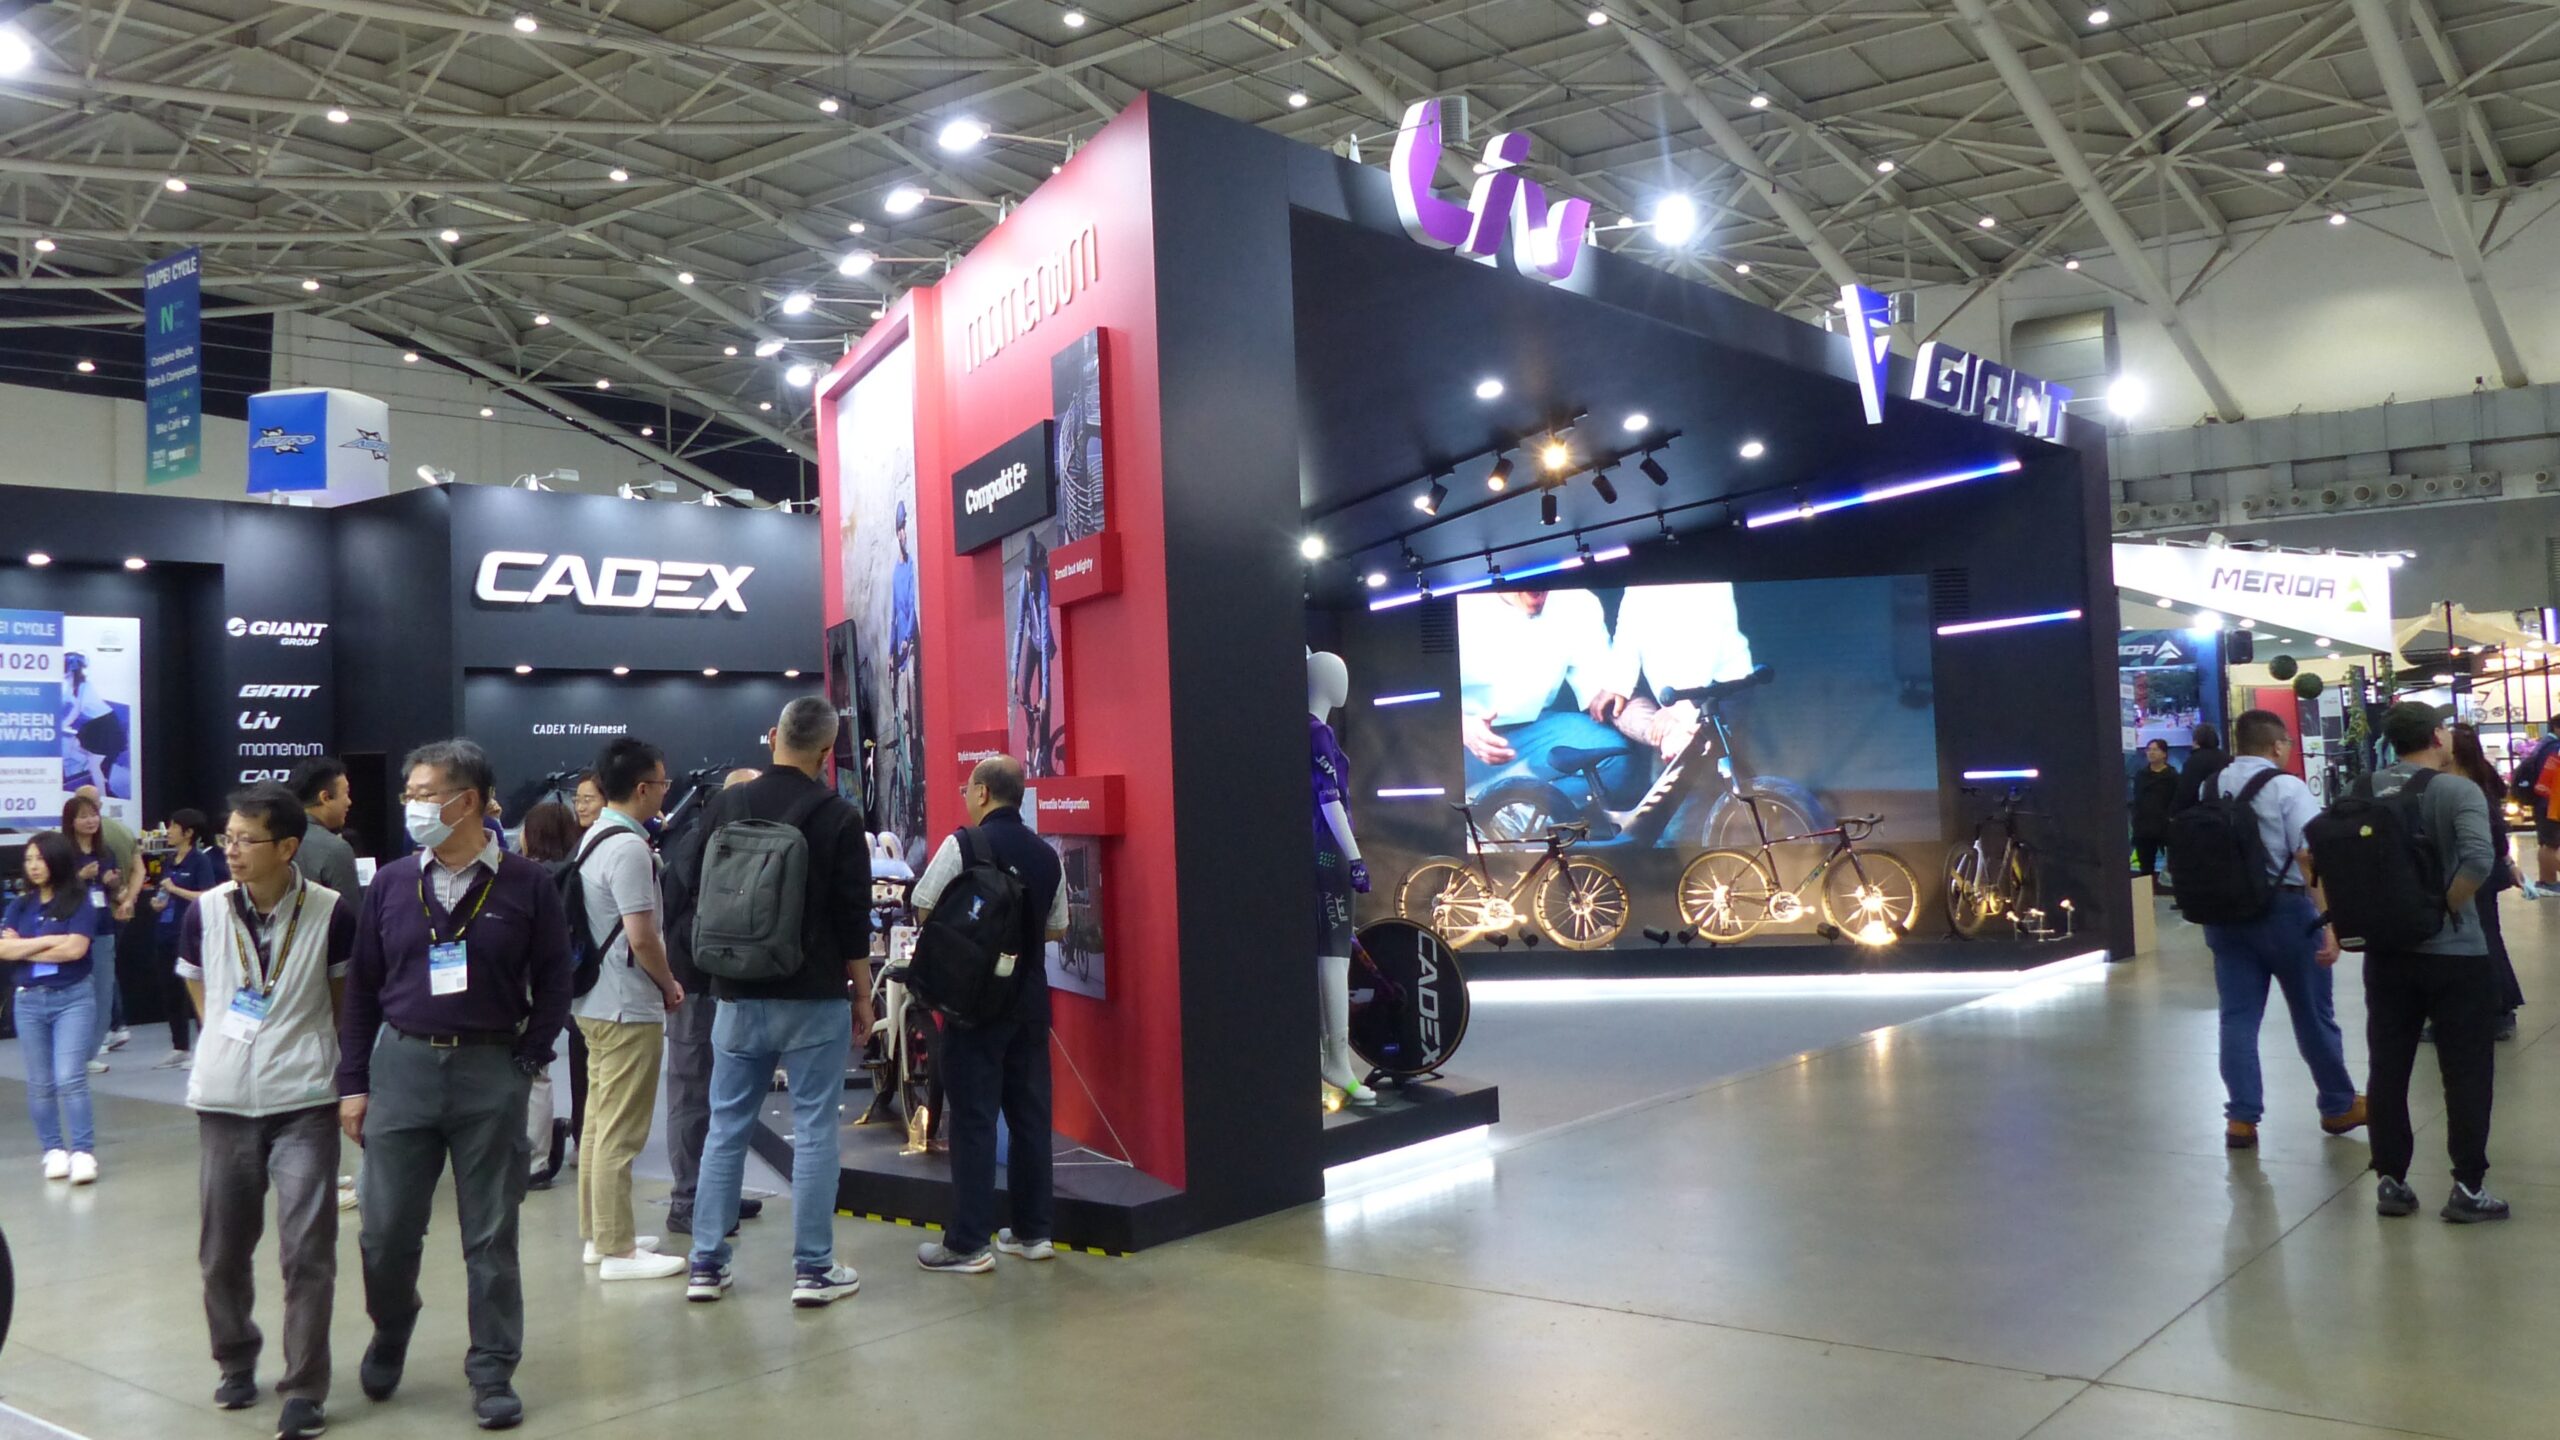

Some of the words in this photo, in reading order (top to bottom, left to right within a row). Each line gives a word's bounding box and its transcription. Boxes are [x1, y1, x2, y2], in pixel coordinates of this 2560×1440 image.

[1390, 97, 1591, 282] Liv
[172, 256, 197, 280] CYCLE
[967, 223, 1099, 374] momentum
[1910, 341, 2073, 442] GIANT
[965, 467, 1013, 515] Compakt
[1013, 462, 1028, 491] E+
[475, 551, 755, 613] CADEX
[2211, 567, 2336, 600] MERIDA
[13, 622, 56, 637] CYCLE
[249, 621, 329, 637] GIANT
[280, 638, 319, 647] GROUP
[239, 684, 321, 698] GIANT
[239, 711, 281, 730] Liv
[533, 723, 567, 735] CADEX
[569, 723, 582, 735] Tri
[583, 723, 627, 735] Frameset
[239, 743, 324, 756] momentum
[240, 769, 291, 783] CAD
[1418, 930, 1441, 1067] CADEX
